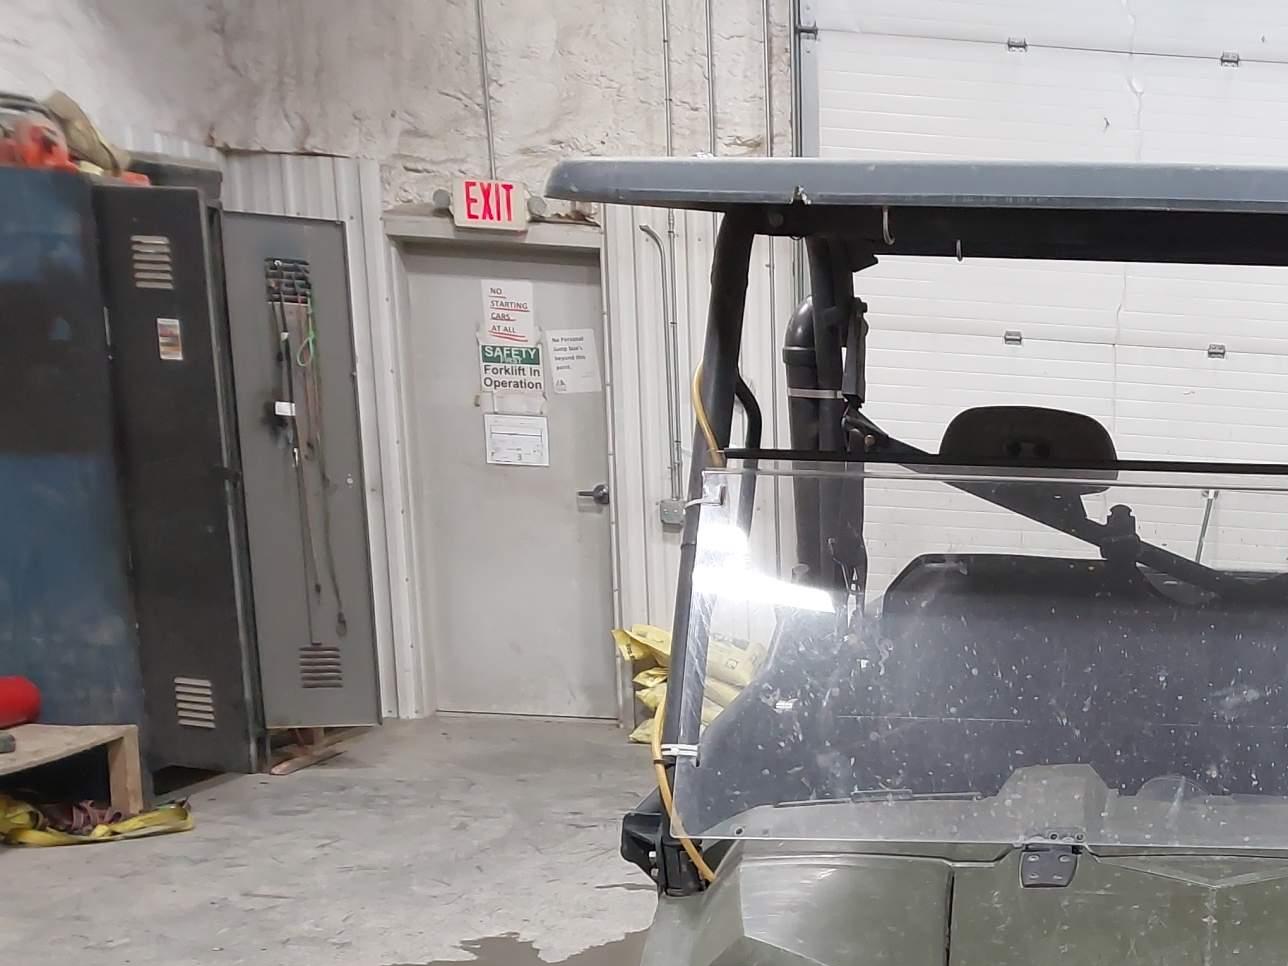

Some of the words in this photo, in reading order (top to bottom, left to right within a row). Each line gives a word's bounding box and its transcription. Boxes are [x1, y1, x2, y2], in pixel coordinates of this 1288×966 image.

[464, 181, 514, 222] EXIT
[490, 287, 503, 295] NO
[490, 300, 528, 310] STARTING
[491, 312, 511, 320] CARS
[484, 346, 537, 359] SAFETY
[484, 365, 526, 376] Forklift
[530, 367, 541, 377] In
[483, 377, 542, 390] Operation
